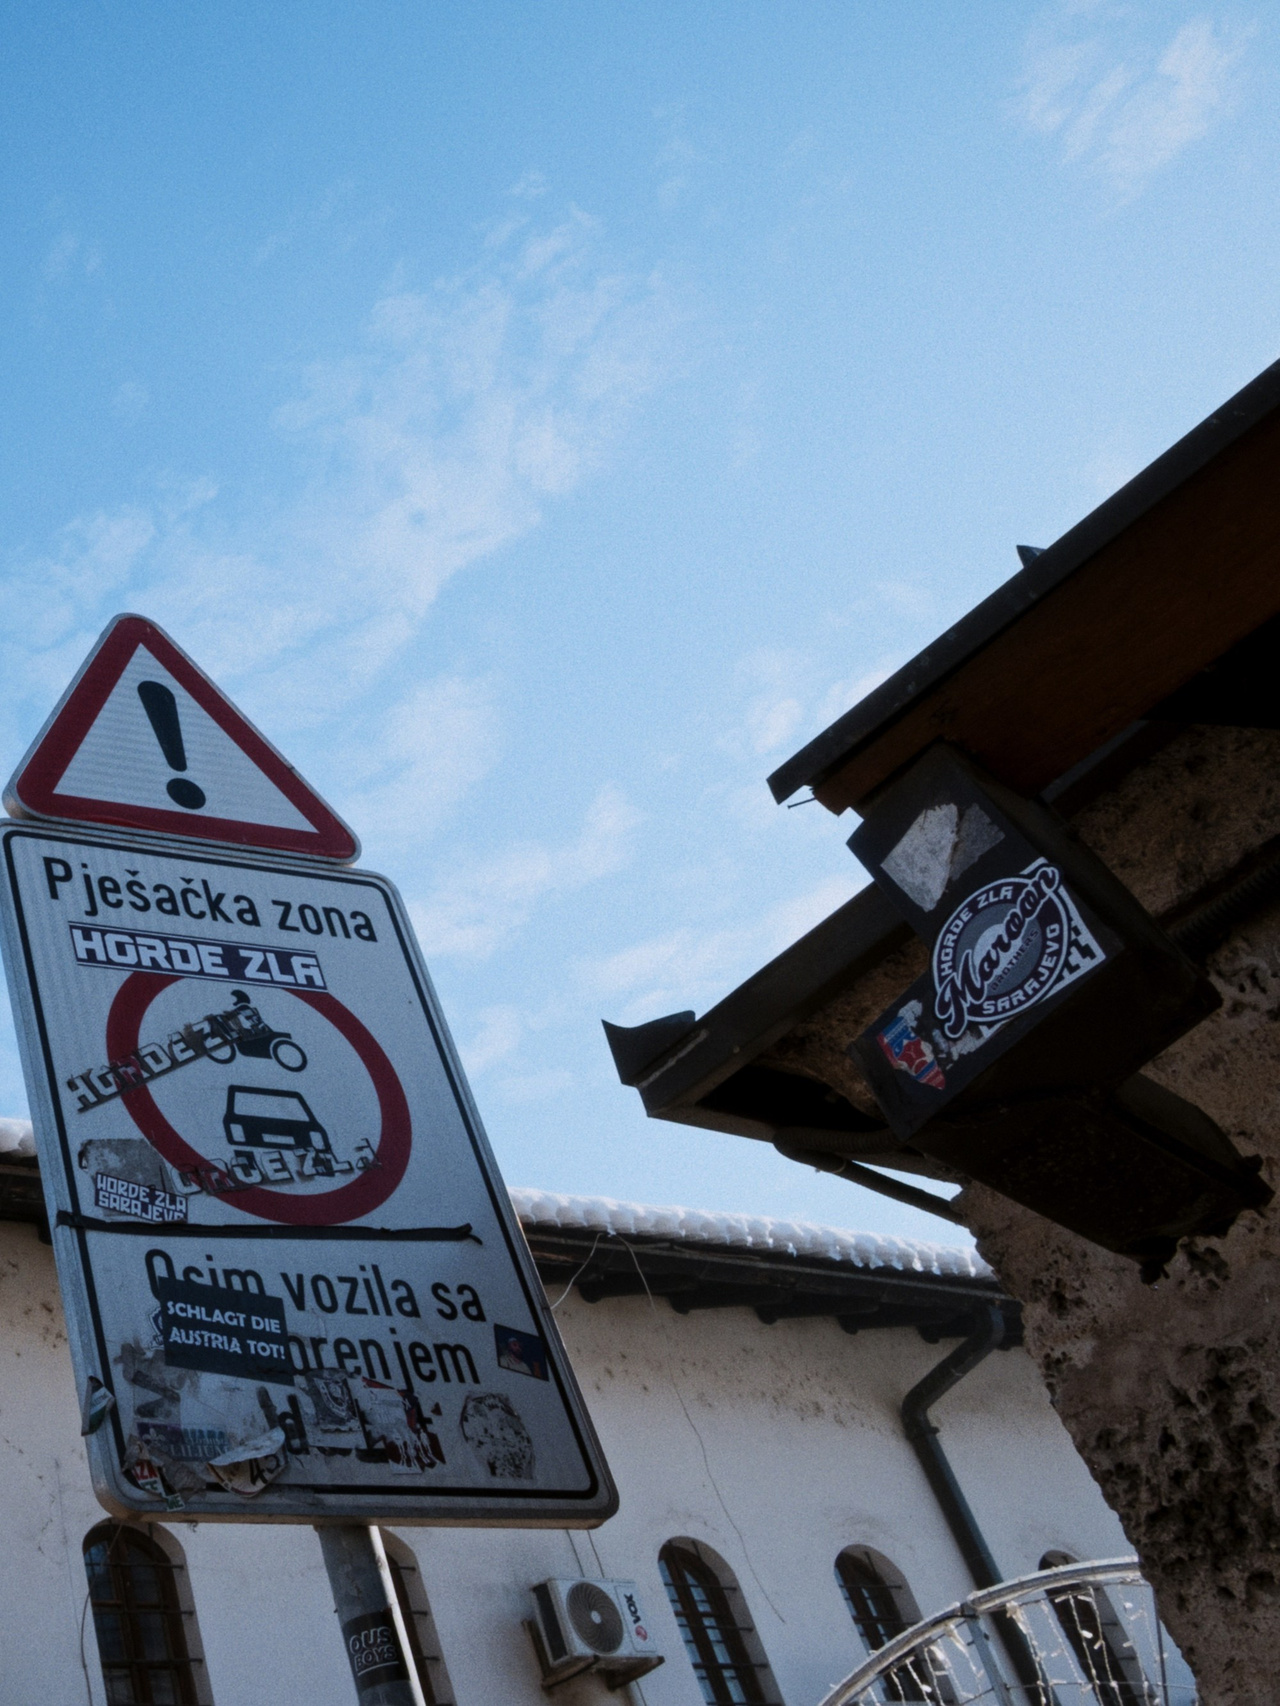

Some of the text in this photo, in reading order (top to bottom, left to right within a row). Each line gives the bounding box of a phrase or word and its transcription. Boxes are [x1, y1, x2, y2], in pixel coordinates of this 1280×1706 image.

[43, 856, 378, 943] Pješačka zona
[71, 928, 327, 988] HORDE ZLA
[936, 865, 1059, 1037] Maroon
[941, 885, 1013, 977] HORDE ZLA
[990, 929, 1040, 993] BROTHERS
[982, 922, 1060, 1015] SARAJEVO
[96, 1173, 187, 1213] HORDE ZLA
[167, 1301, 281, 1334] SCHLAGT DIE
[280, 1264, 421, 1318] vozila
[431, 1282, 487, 1322] sa
[169, 1326, 242, 1354] AUSTRIA
[246, 1339, 286, 1360] TOT!
[354, 1645, 397, 1671] BOYS
